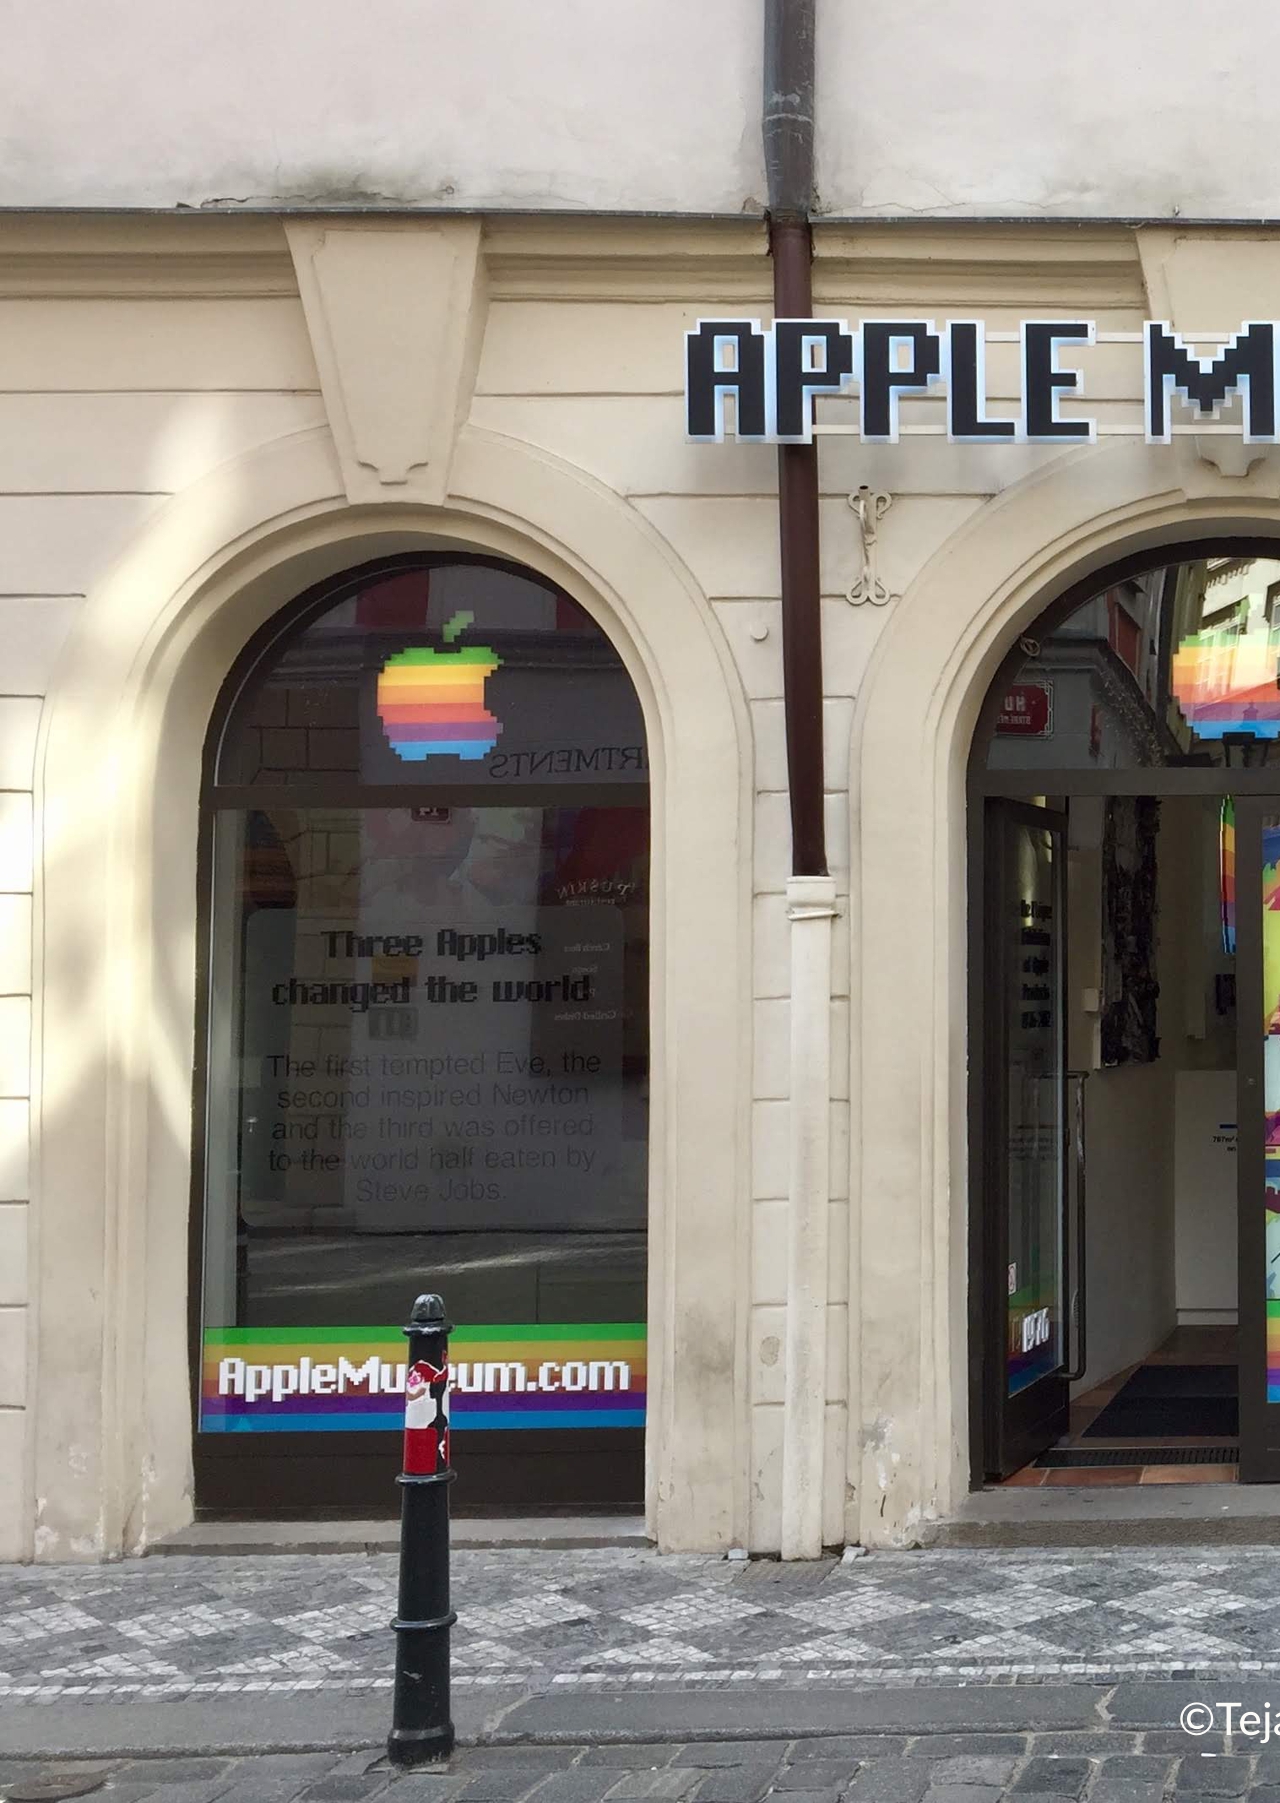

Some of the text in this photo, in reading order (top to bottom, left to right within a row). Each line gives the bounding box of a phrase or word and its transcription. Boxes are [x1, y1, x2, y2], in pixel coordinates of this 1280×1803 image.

[685, 319, 1096, 444] APPLE
[320, 928, 542, 961] Three Apples
[272, 977, 410, 1013] changed
[425, 976, 477, 1003] the
[493, 974, 591, 1002] world
[266, 1051, 601, 1080] The first tempted Eve, the
[277, 1085, 589, 1112] second inspired Newton
[272, 1113, 594, 1141] and the third was offered
[269, 1147, 596, 1173] to the world half eaten by
[356, 1178, 507, 1202] Steve Jobs.
[218, 1356, 631, 1402] AppleMuum.com
